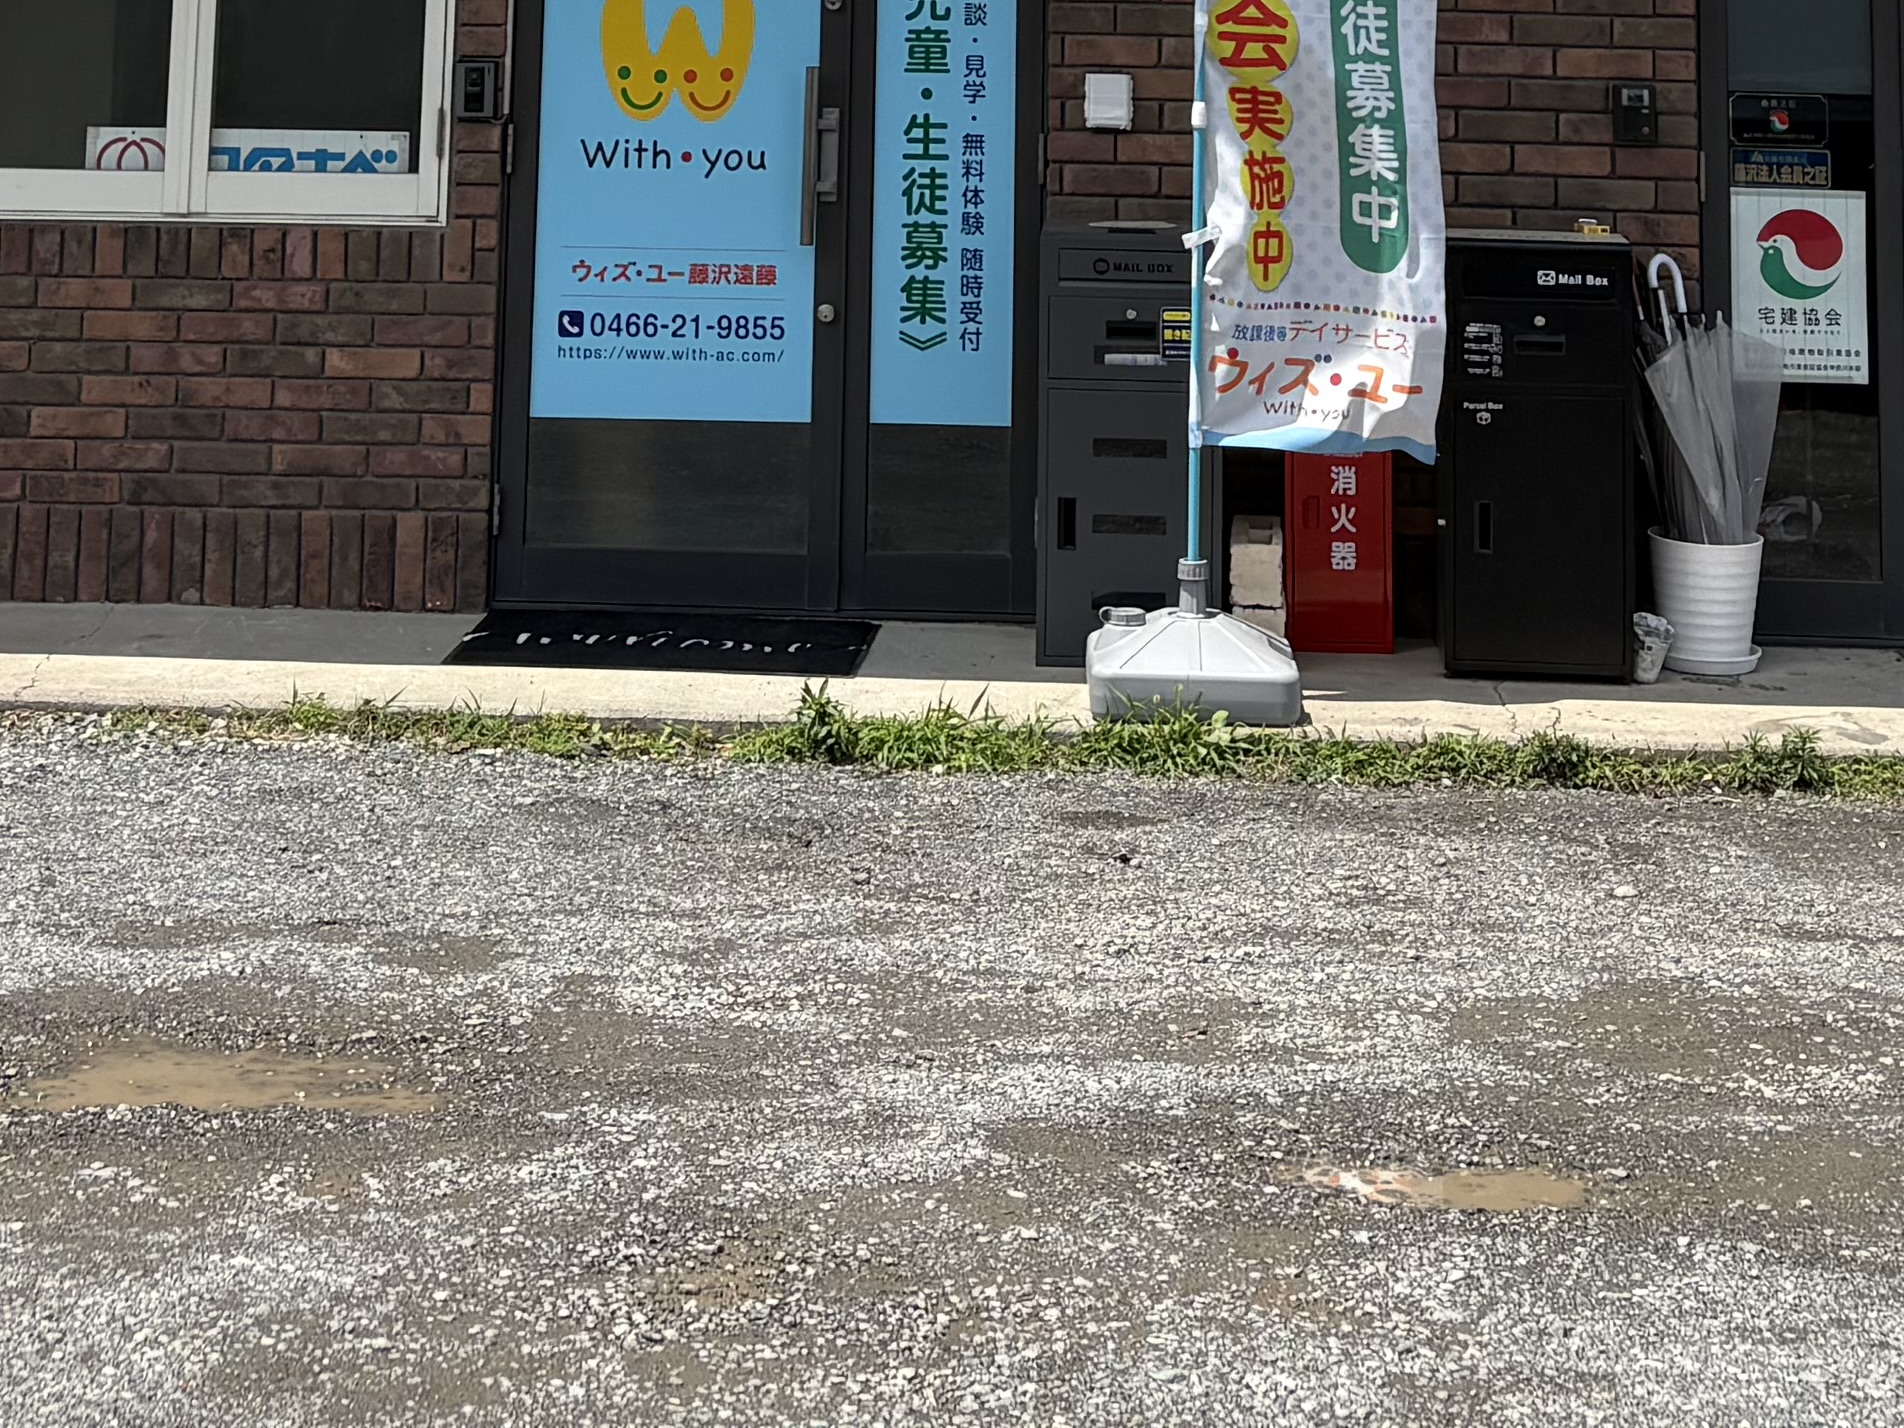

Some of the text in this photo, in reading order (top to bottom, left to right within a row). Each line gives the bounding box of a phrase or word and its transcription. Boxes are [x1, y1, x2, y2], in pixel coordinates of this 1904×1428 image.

[1113, 261, 1143, 272] MAIL
[1558, 274, 1608, 286] Mail Box
[590, 311, 786, 341] 0466-21-9855
[1757, 306, 1843, 328] 宅建協会
[557, 345, 785, 364] https://www.with-ac.com/
[1208, 347, 1423, 405] ウィズ・ユー
[1330, 465, 1357, 570] 消火器
